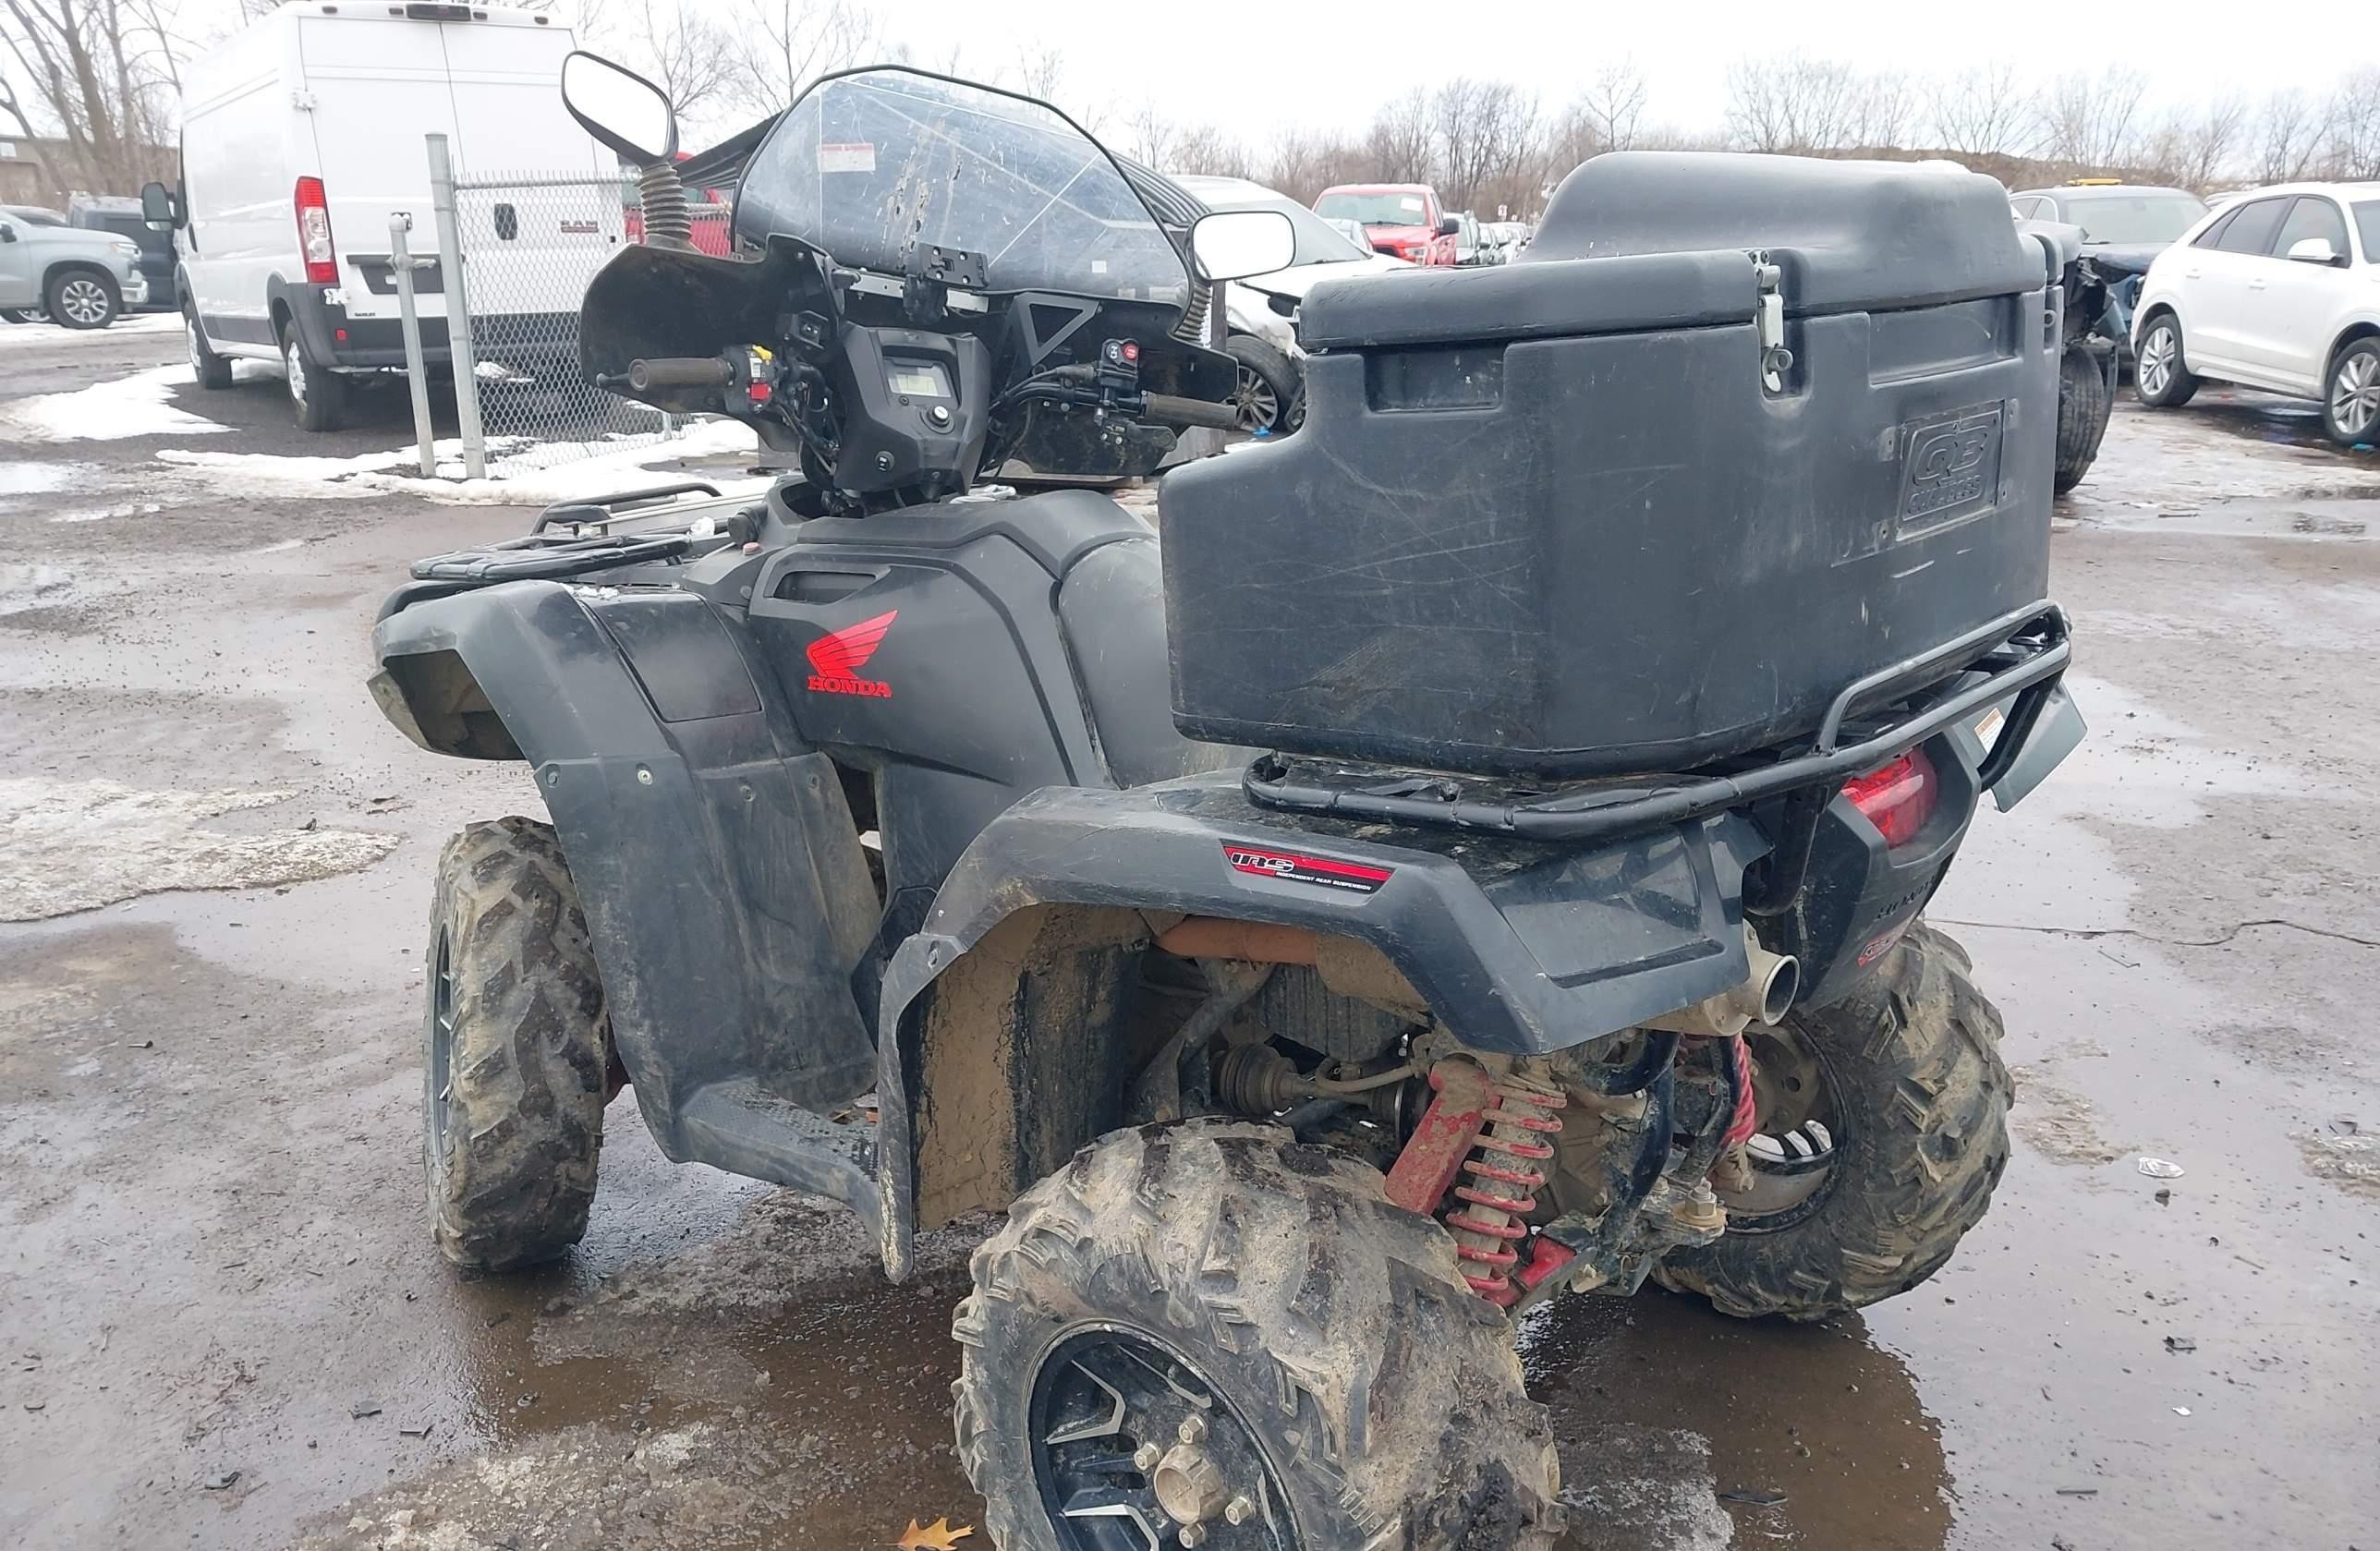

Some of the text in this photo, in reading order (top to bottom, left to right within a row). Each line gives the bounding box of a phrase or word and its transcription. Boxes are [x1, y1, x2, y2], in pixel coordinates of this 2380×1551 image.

[561, 220, 599, 228] RAM
[808, 675, 892, 697] HONDA
[1231, 852, 1294, 872] IRS
[1276, 871, 1314, 881] INDEPENDENT
[1332, 879, 1372, 891] SUSPENSION
